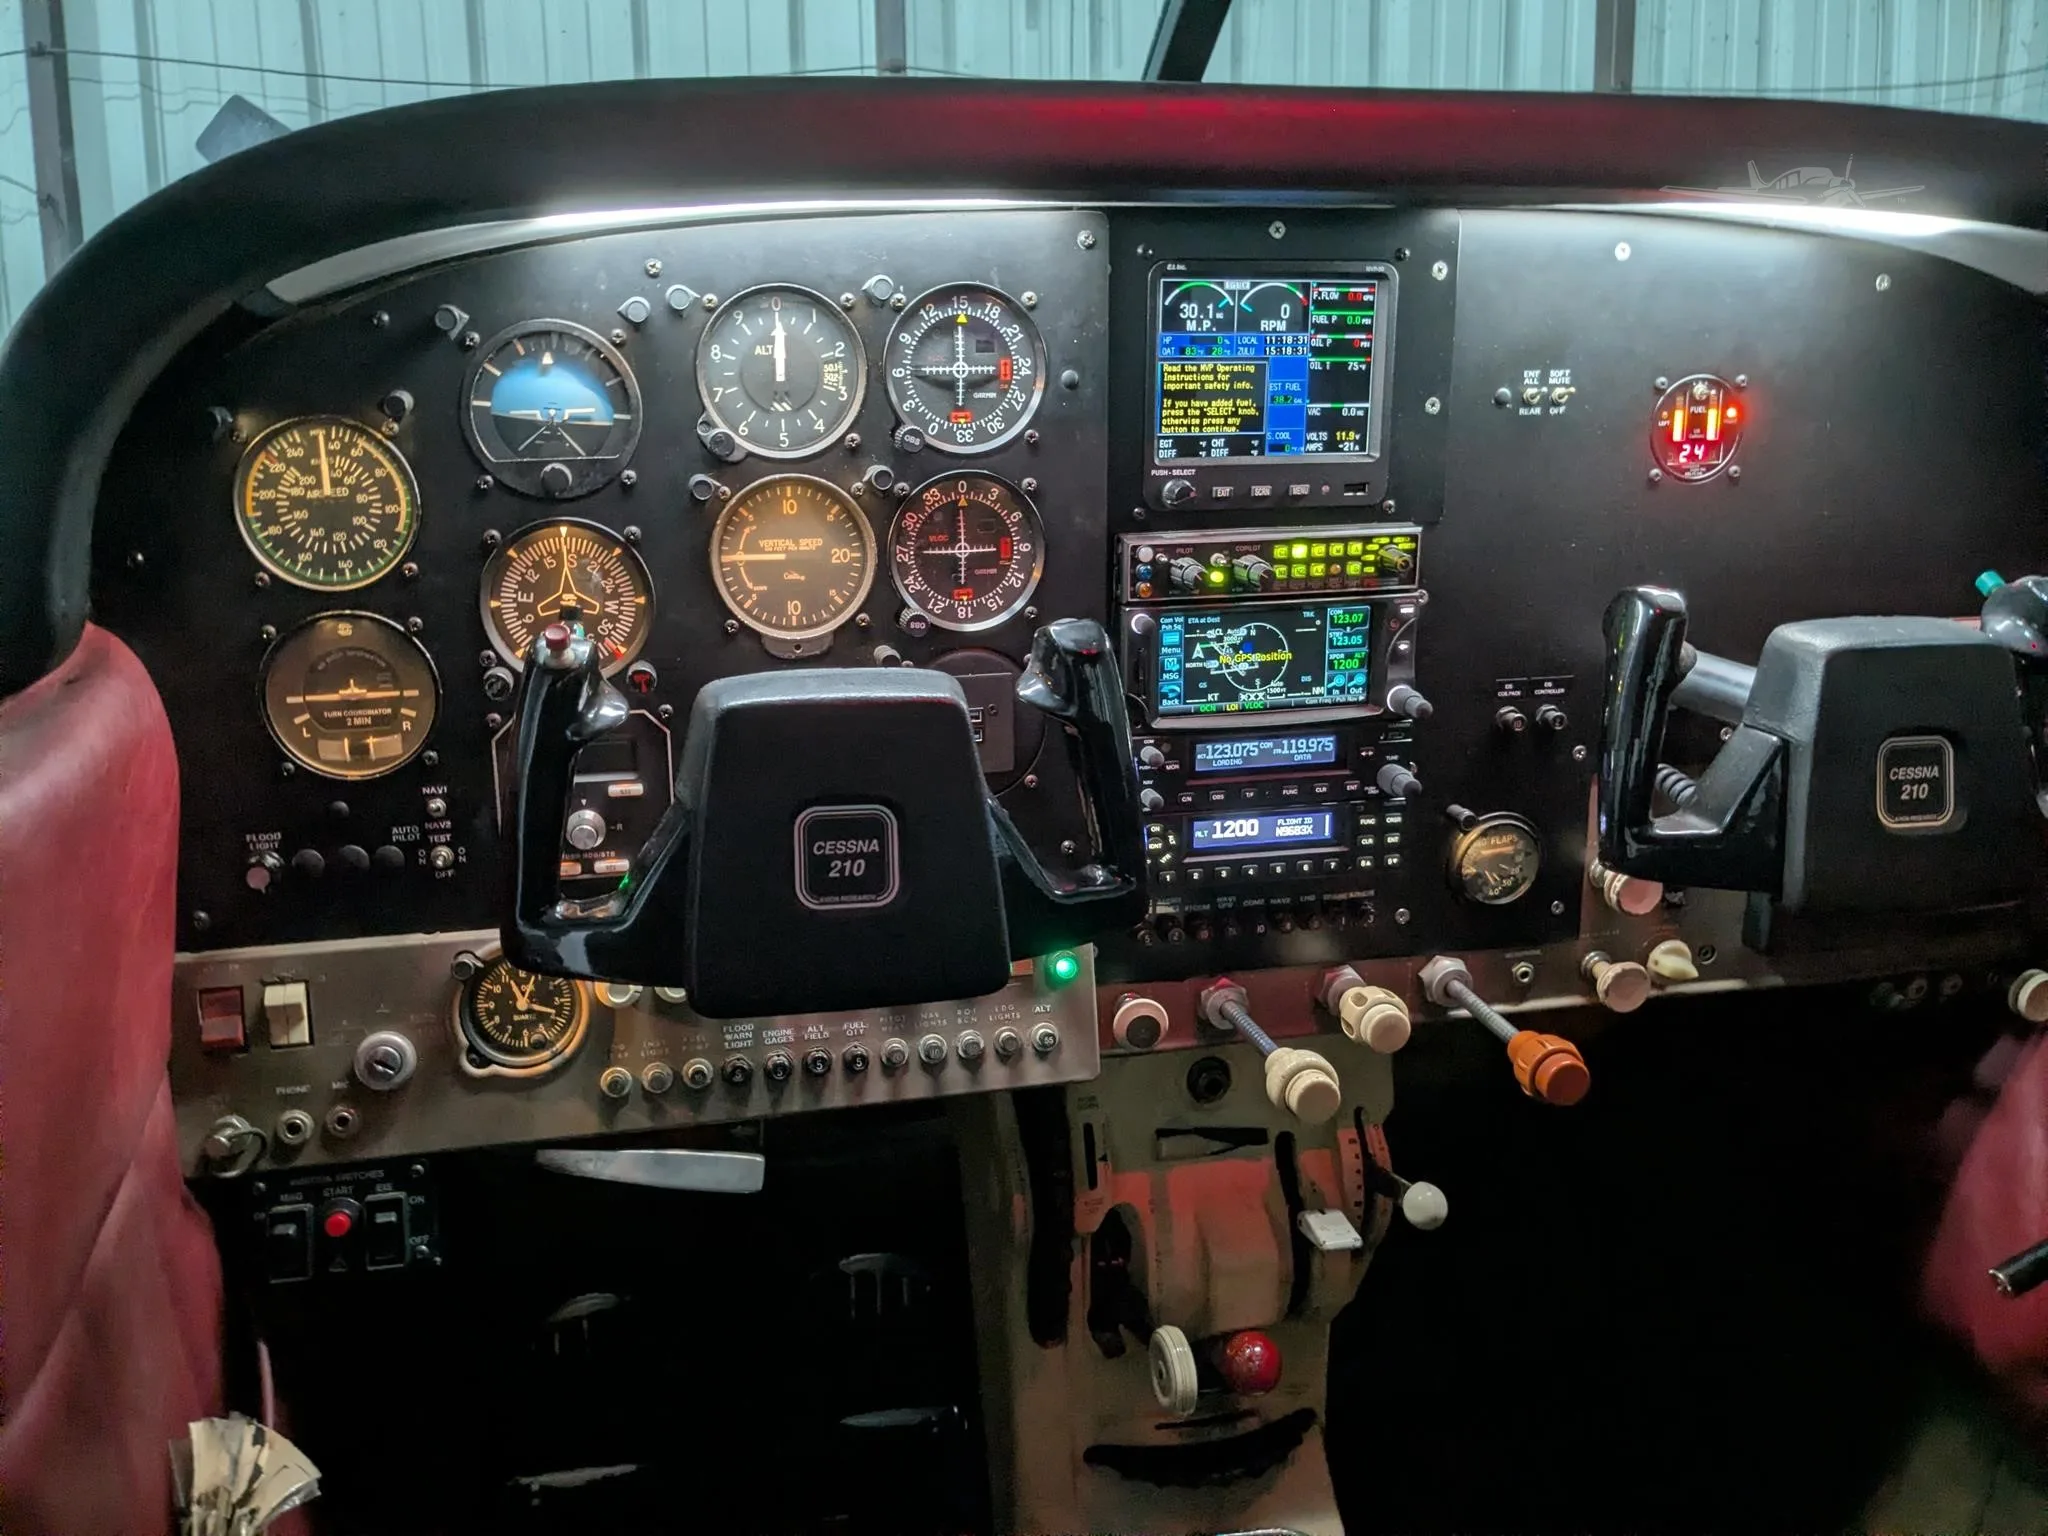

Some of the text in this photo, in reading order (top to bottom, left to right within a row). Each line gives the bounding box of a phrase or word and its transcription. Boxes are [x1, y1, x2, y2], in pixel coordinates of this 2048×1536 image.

[771, 297, 781, 311] 0
[952, 296, 968, 308] 15
[920, 303, 938, 320] 12
[984, 302, 1000, 319] 18
[1180, 304, 1213, 319] 30.1
[1280, 304, 1290, 319] 0
[733, 311, 743, 325] 9
[1312, 315, 1329, 324] FUEL
[1186, 320, 1216, 331] M.P.
[1261, 320, 1286, 331] RPM
[1006, 324, 1024, 342] 21
[898, 332, 912, 345] 9
[1265, 336, 1308, 344] 11:18:31
[711, 345, 721, 359] 8
[755, 345, 773, 355] ALT
[835, 342, 845, 357] 2
[1237, 347, 1255, 355] ZULU
[1019, 358, 1031, 376] 24
[1163, 364, 1181, 372] Read
[1217, 364, 1255, 373] Operating
[892, 368, 905, 378] 6
[1164, 373, 1214, 381] Instructions
[1524, 370, 1541, 378] ENT
[1550, 369, 1571, 377] SOFT
[1204, 382, 1230, 390] safety
[1234, 381, 1253, 389] info.
[1524, 377, 1539, 385] ALL
[713, 388, 723, 402] 7
[838, 387, 847, 400] 3
[903, 399, 915, 412] 3
[1013, 391, 1026, 411] 27
[1163, 399, 1172, 407] If
[1175, 400, 1188, 408] you
[1211, 399, 1233, 407] added
[1162, 409, 1184, 417] press
[1188, 408, 1200, 416] the
[1519, 407, 1541, 416] REAR
[814, 419, 825, 432] 4
[986, 416, 1005, 434] 30
[1203, 418, 1224, 426] press
[1228, 417, 1241, 425] any
[739, 421, 748, 435] 6
[928, 422, 938, 435] 0
[1202, 425, 1239, 433] continue.
[780, 433, 789, 447] 5
[956, 429, 974, 443] 33
[1306, 432, 1355, 440] VOLTS 11.9
[287, 448, 303, 458] 240
[351, 448, 363, 457] 60
[1159, 449, 1177, 457] DIFF
[1211, 449, 1229, 457] DIFF
[1679, 444, 1704, 463] 24
[270, 464, 285, 472] 220
[299, 476, 316, 485] 200
[344, 476, 355, 484] 60
[958, 480, 967, 493] 0
[259, 490, 275, 499] 200
[923, 488, 940, 505] 33
[988, 488, 999, 500] 3
[385, 505, 398, 513] 100
[783, 500, 797, 514] 10
[353, 517, 366, 525] 100
[902, 512, 917, 530] 30
[1011, 512, 1022, 521] 6
[333, 533, 346, 541] 120
[759, 538, 823, 547] VERTICAL SPEED
[1019, 543, 1031, 551] 9
[831, 549, 850, 563] 20
[896, 545, 908, 562] 27
[543, 557, 556, 569] 15
[568, 554, 577, 568] S
[904, 576, 921, 593] 24
[1010, 572, 1024, 588] 12
[518, 592, 534, 602] E
[604, 601, 619, 614] W
[788, 601, 801, 615] 10
[928, 599, 945, 613] 21
[987, 596, 1004, 611] 15
[958, 606, 973, 618] 18
[1334, 613, 1363, 624] 123.07
[1332, 636, 1362, 646] 123.05
[1220, 651, 1291, 663] No GPS Position
[1333, 659, 1359, 669] 1200
[344, 708, 391, 716] COORDINATOR
[354, 717, 371, 725] MIN
[402, 721, 411, 731] R
[303, 728, 311, 738] L
[1206, 738, 1333, 759] 123.075 119.975
[1889, 765, 1939, 781] CESSNA
[1901, 784, 1928, 800] 210
[392, 825, 419, 834] AUTO
[425, 821, 451, 829] NAV2
[1212, 819, 1259, 838] 1200
[246, 832, 282, 842] FLOOD
[392, 833, 421, 842] PILOT
[428, 834, 451, 843] TEST
[1491, 835, 1518, 844] FLAPS
[813, 838, 879, 855] CESSNA
[829, 859, 865, 877] 210
[1034, 1005, 1051, 1013] ALT
[763, 1028, 794, 1038] ENGINE
[807, 1025, 823, 1033] ALT
[847, 1028, 864, 1036] QTY
[725, 1032, 752, 1040] WARN
[765, 1036, 794, 1045] GAGES
[804, 1032, 829, 1040] FIELD
[276, 1085, 311, 1094] PHONE
[323, 1186, 353, 1197] START
